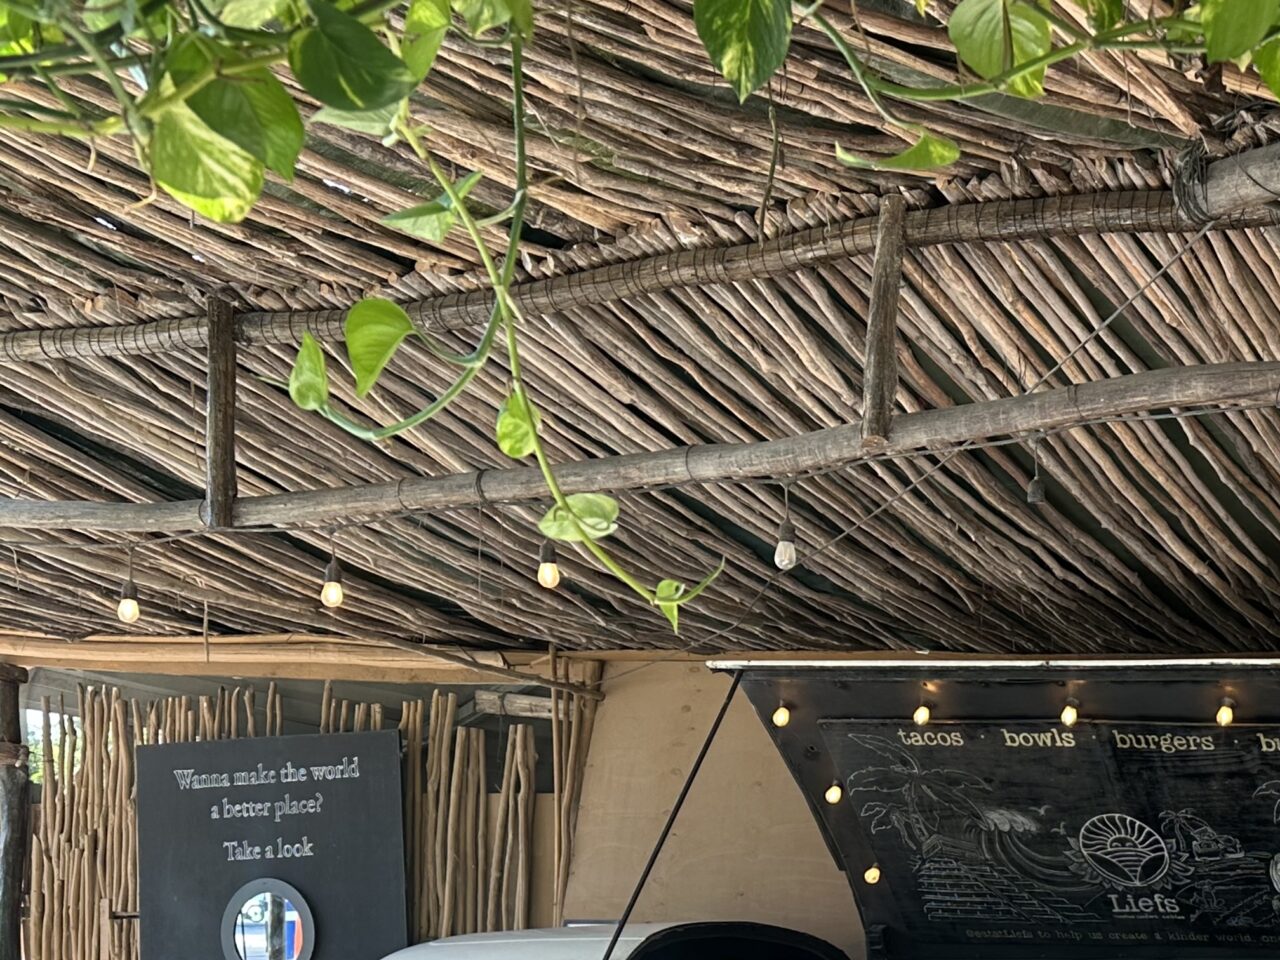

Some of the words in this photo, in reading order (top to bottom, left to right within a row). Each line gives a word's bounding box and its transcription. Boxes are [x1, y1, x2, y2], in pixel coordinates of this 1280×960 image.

[897, 729, 965, 748] tacos
[1003, 728, 1077, 749] bowls
[1116, 729, 1216, 754] burgers
[173, 768, 231, 791] Wanna
[233, 763, 277, 786] make
[280, 762, 308, 783] the
[310, 757, 360, 780] world
[210, 803, 220, 819] a
[223, 797, 271, 818] better
[274, 792, 324, 822] place?
[223, 841, 262, 862] Take
[264, 844, 275, 859] a
[277, 836, 315, 859] look
[1106, 893, 1181, 913] Liefs
[1038, 930, 1051, 939] to
[1055, 929, 1083, 941] help
[1088, 931, 1104, 940] us
[1108, 931, 1148, 941] create
[1153, 932, 1163, 941] a
[1167, 930, 1210, 942] kinder
